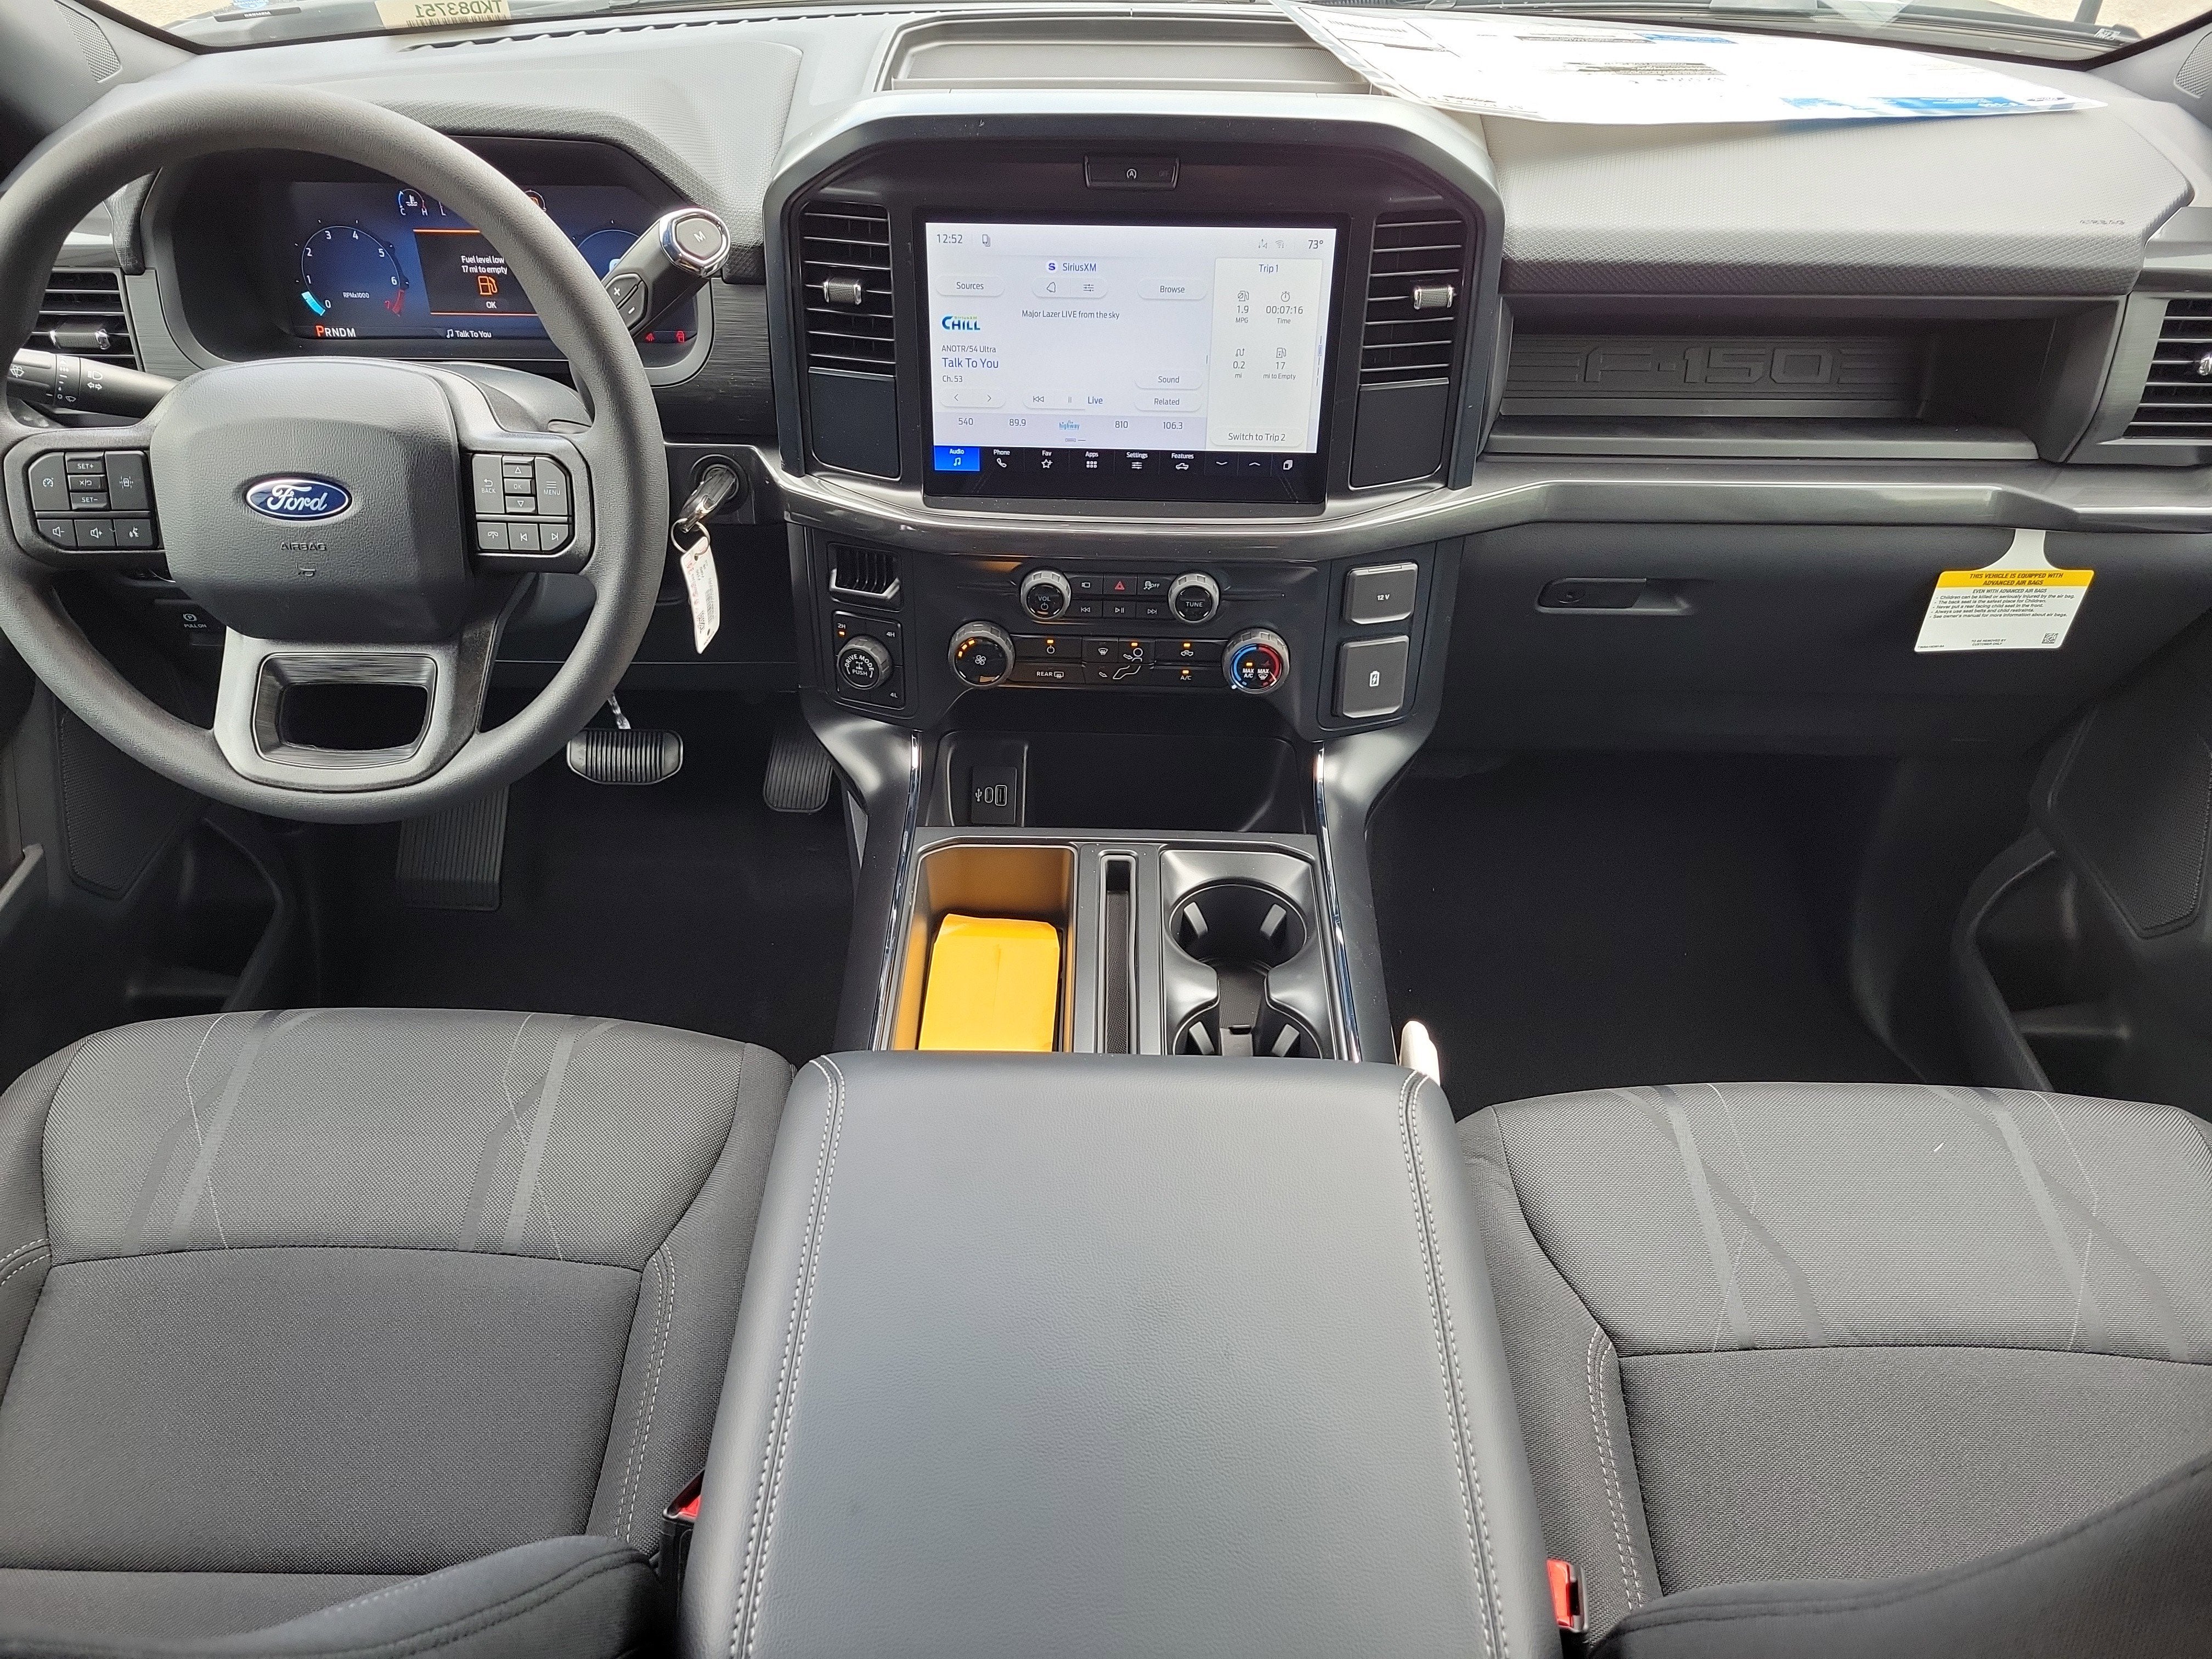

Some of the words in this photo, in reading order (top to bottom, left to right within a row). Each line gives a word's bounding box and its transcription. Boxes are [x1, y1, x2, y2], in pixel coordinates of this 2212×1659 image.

[325, 231, 331, 239] 3
[353, 230, 358, 239] 4
[693, 231, 706, 242] M
[936, 234, 963, 244] 12:52
[1308, 240, 1323, 249] 73°
[306, 248, 312, 256] 2
[378, 249, 385, 257] 5
[487, 266, 507, 274] empty
[1063, 263, 1097, 272] SiriusXM
[1259, 264, 1273, 274] Trip
[1276, 264, 1278, 273] 1
[307, 275, 312, 284] 1
[391, 276, 397, 285] 6
[956, 281, 984, 290] Sources
[325, 300, 331, 308] 0
[1237, 305, 1249, 313] 1.9
[1266, 306, 1303, 314] 00:07:16
[1022, 310, 1041, 319] Major
[1108, 311, 1120, 320] sky
[942, 316, 980, 330] CHILL
[942, 358, 963, 368] Talk
[965, 358, 977, 368] To
[980, 358, 998, 369] You
[1233, 361, 1245, 369] 0.2
[1584, 347, 1836, 384] F-150
[1009, 419, 1026, 427] 89.9
[1163, 421, 1183, 430] 106.3
[1228, 432, 1254, 441] Switch
[1255, 433, 1263, 441] to
[1265, 433, 1279, 442] Trip
[267, 484, 328, 511] Ford
[280, 542, 326, 551] AIRBAG
[845, 654, 858, 668] DRIVE
[859, 655, 874, 671] MODE
